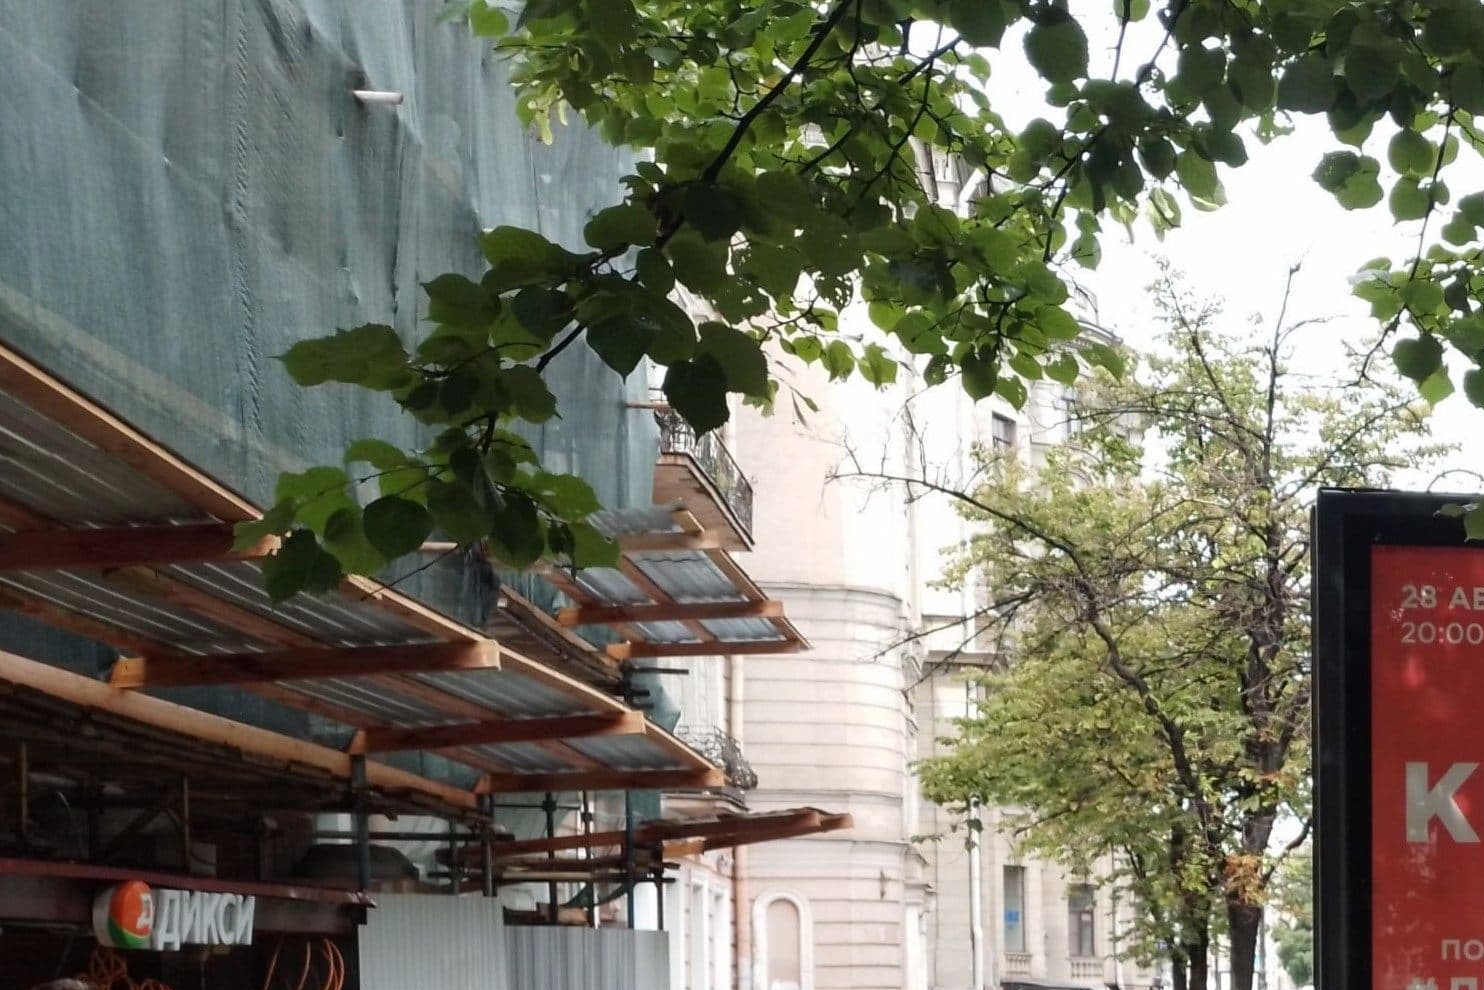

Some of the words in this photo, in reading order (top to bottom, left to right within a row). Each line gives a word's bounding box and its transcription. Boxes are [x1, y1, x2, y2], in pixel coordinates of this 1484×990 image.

[1400, 584, 1437, 609] 28
[1400, 621, 1484, 645] 20:00
[155, 888, 256, 952] ДИКСИ
